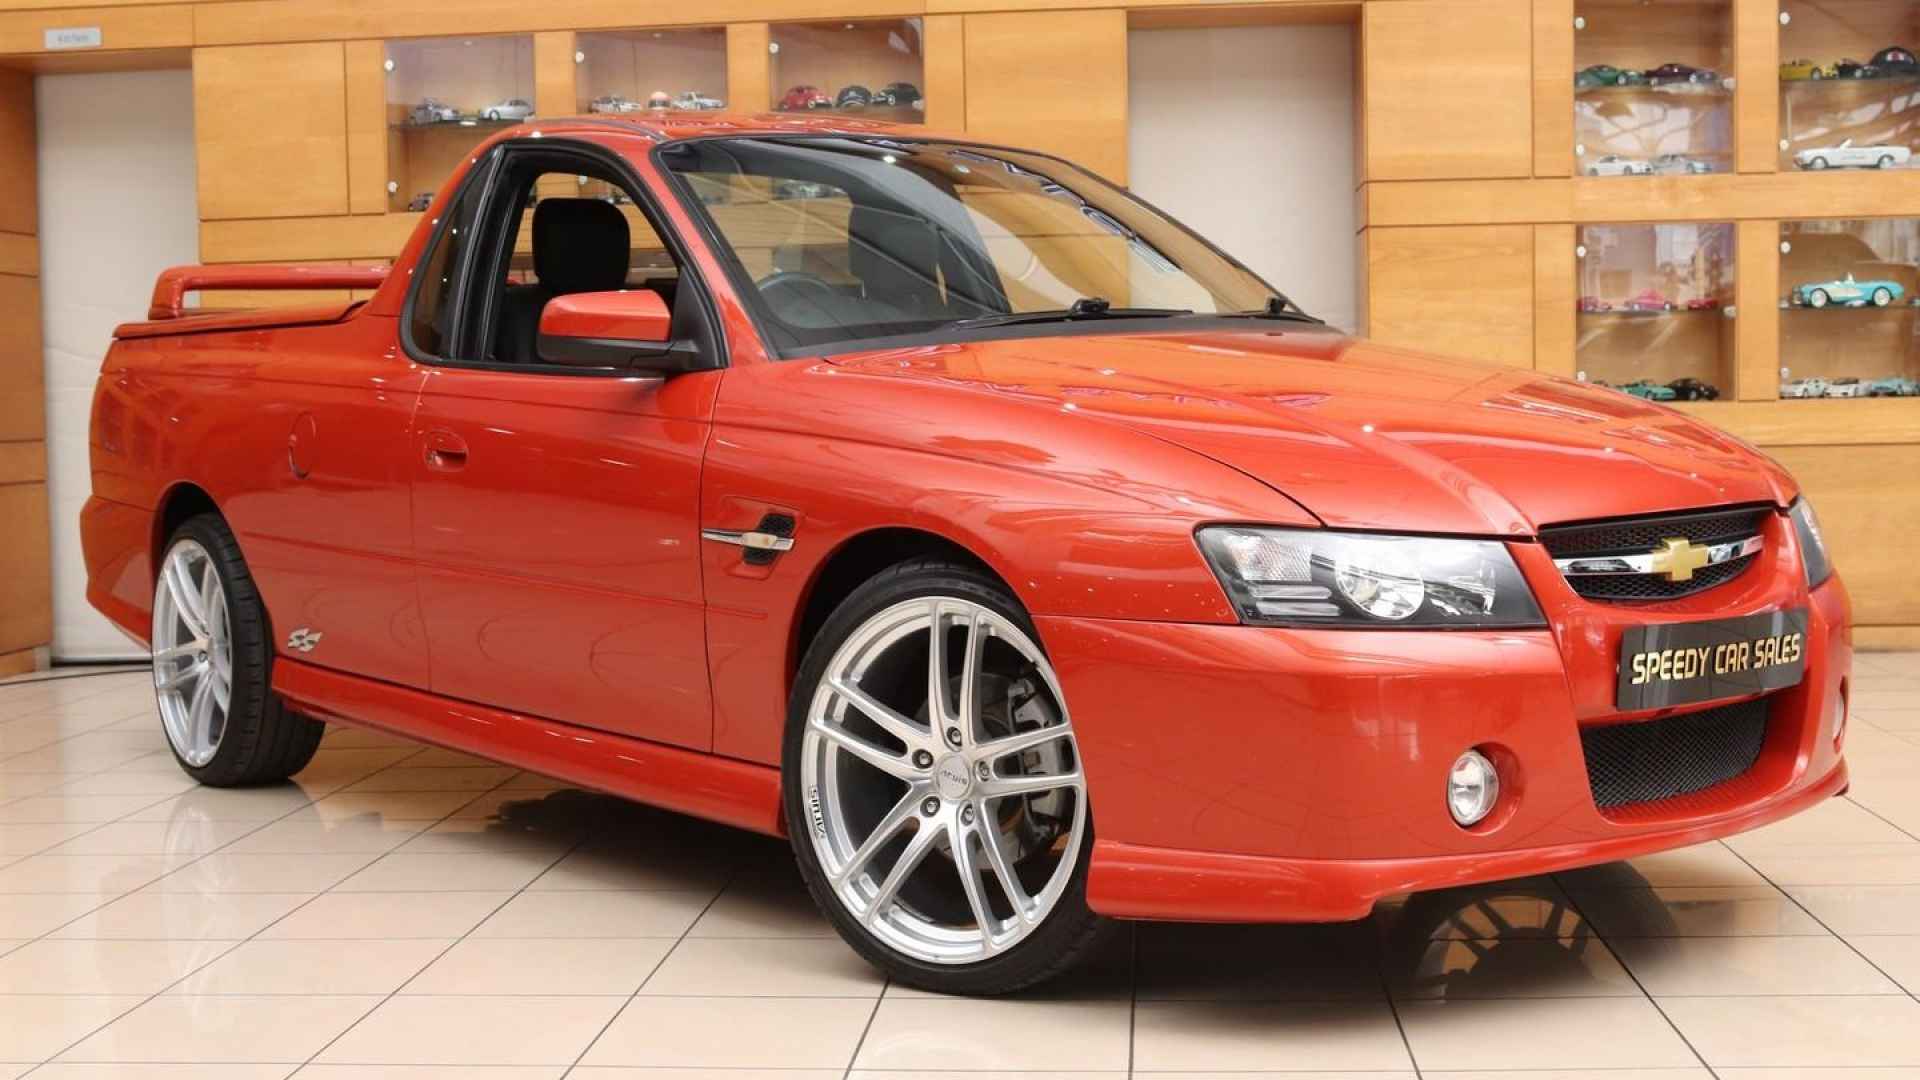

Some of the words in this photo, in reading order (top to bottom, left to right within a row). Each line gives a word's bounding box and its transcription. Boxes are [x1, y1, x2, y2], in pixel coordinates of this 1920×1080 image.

[1631, 647, 1711, 685] SPEEDY
[1714, 641, 1749, 675] CAR
[1753, 632, 1801, 669] SALES
